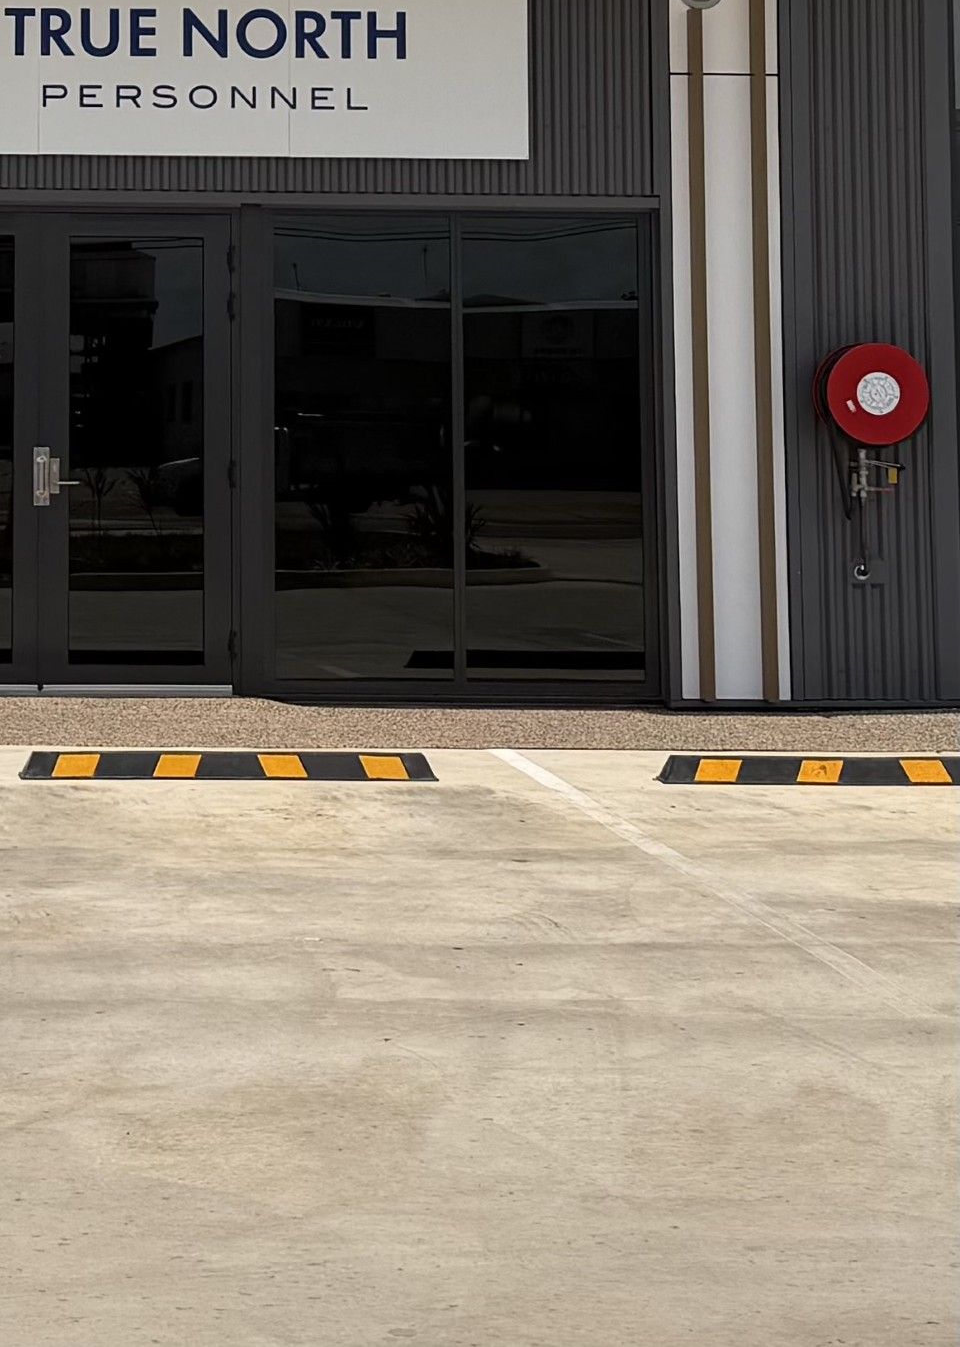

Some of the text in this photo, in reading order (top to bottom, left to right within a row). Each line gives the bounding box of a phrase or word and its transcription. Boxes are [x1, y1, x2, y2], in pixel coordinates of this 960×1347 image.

[3, 7, 407, 60] TRUE NORTH
[42, 84, 369, 111] PERSONNEL
